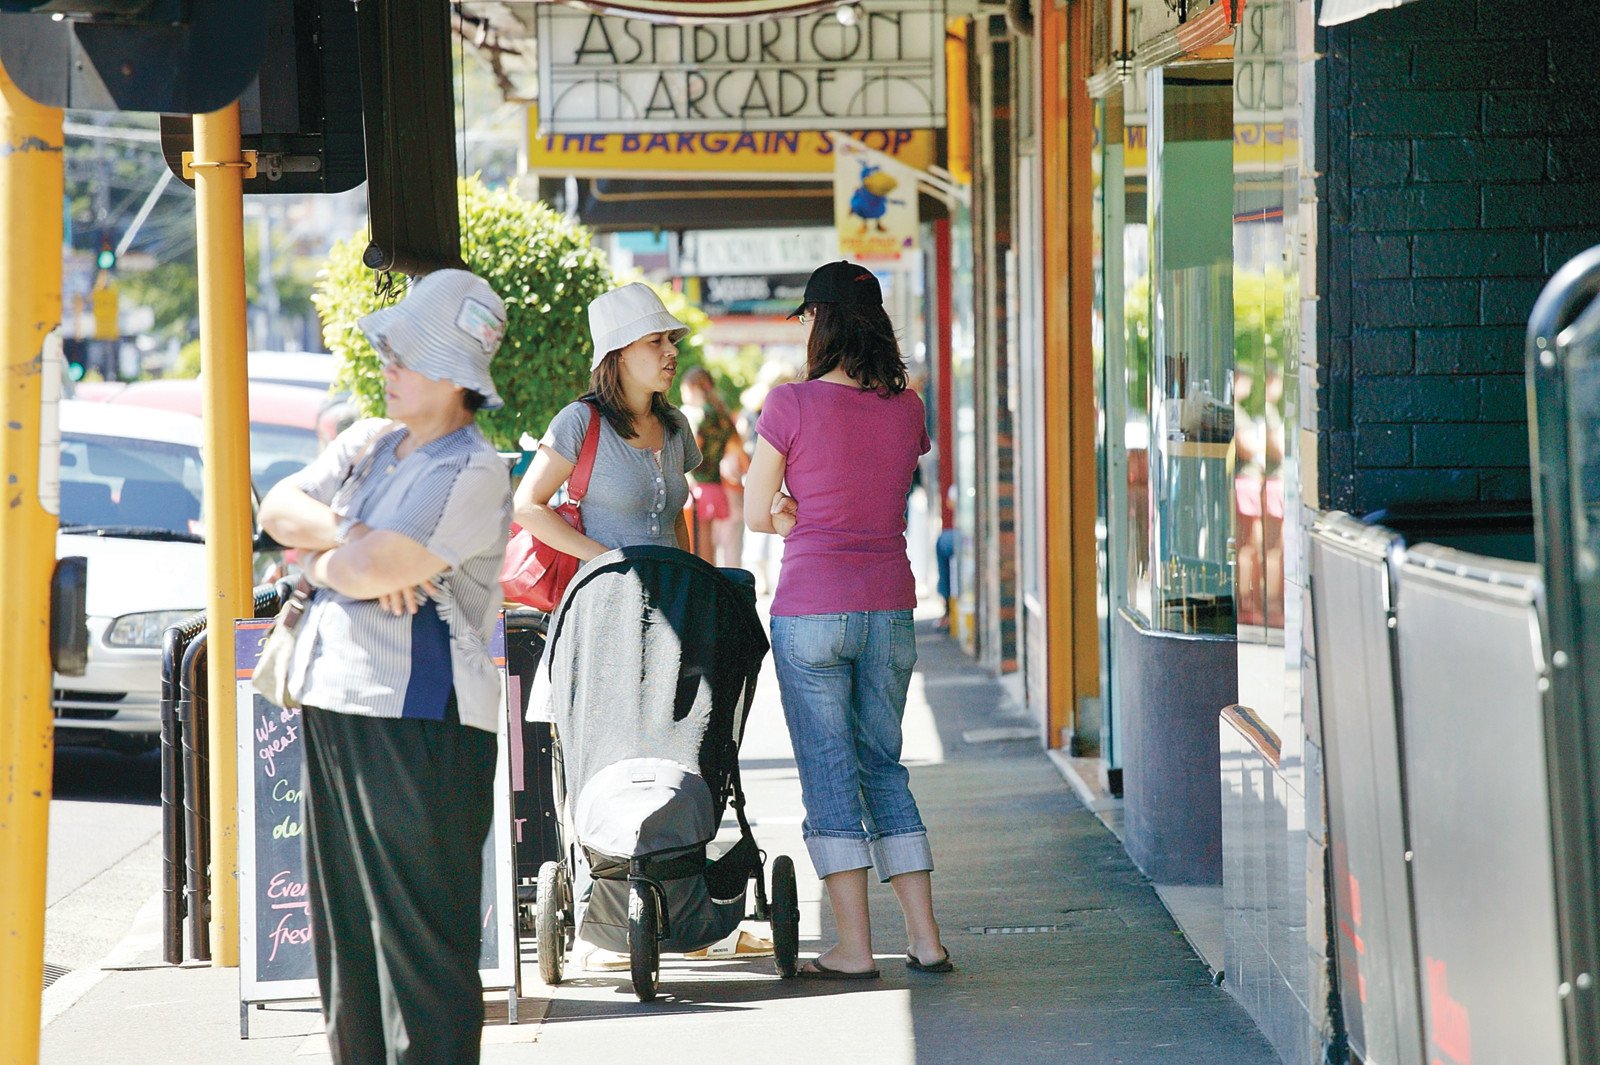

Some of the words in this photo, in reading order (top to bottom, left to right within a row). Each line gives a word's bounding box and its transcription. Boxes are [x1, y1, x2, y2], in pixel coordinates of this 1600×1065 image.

[645, 69, 836, 119] ARCADE
[545, 132, 608, 152] THE
[620, 131, 799, 153] BARGAIN
[816, 129, 913, 155] SOP
[256, 715, 278, 742] We
[259, 725, 298, 777] great
[267, 870, 311, 915] Ever
